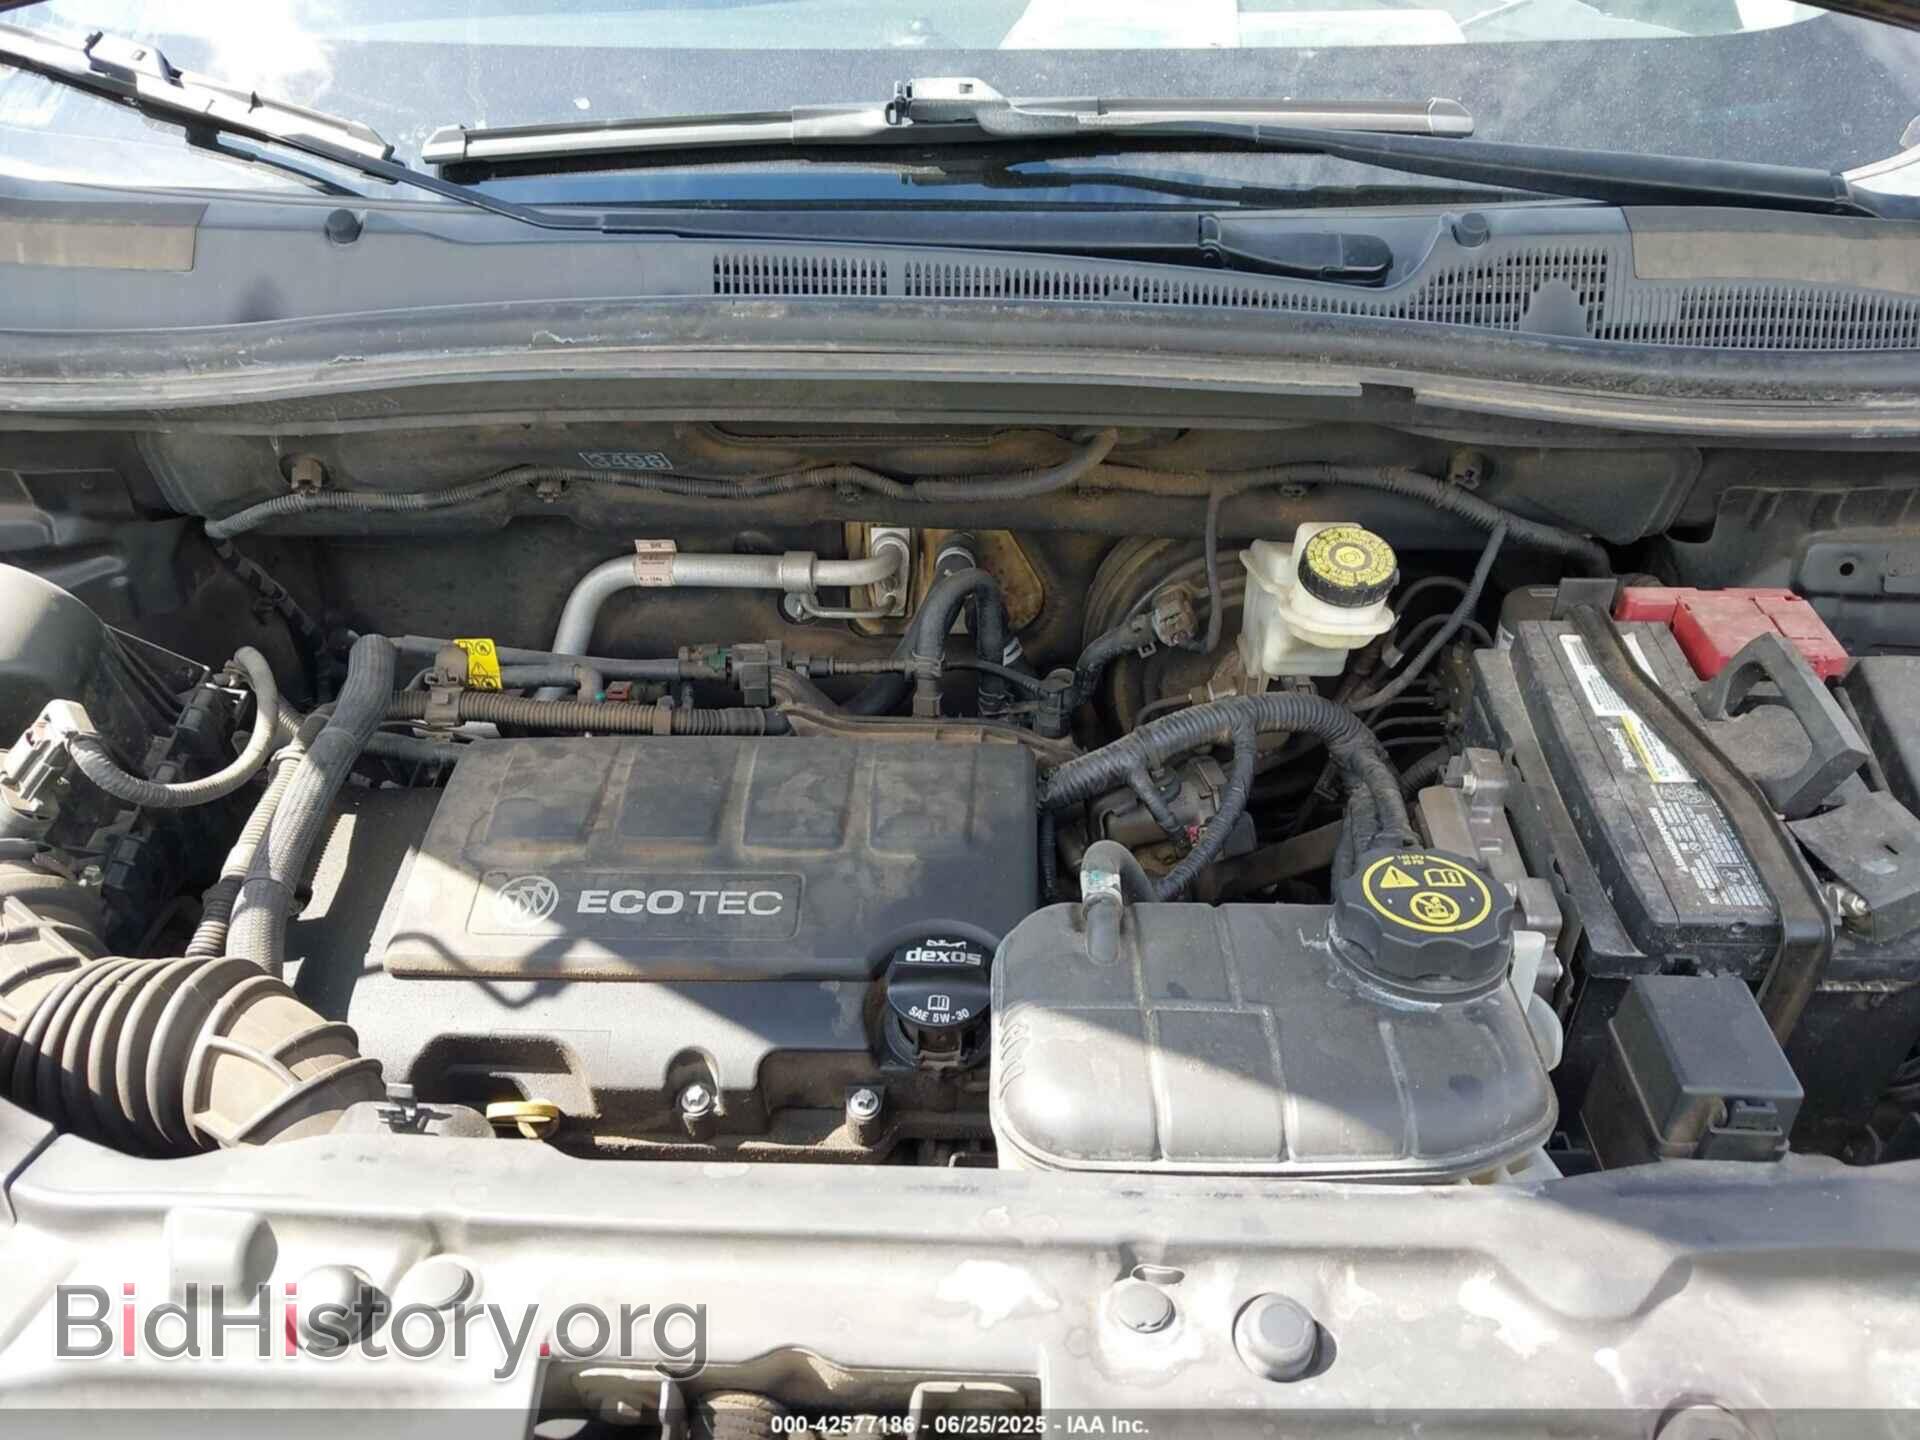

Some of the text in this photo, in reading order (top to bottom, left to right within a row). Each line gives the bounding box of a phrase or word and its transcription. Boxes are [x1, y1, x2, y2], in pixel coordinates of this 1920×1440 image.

[905, 947, 982, 966] dexos
[908, 1006, 970, 1023] SAE 5W-30
